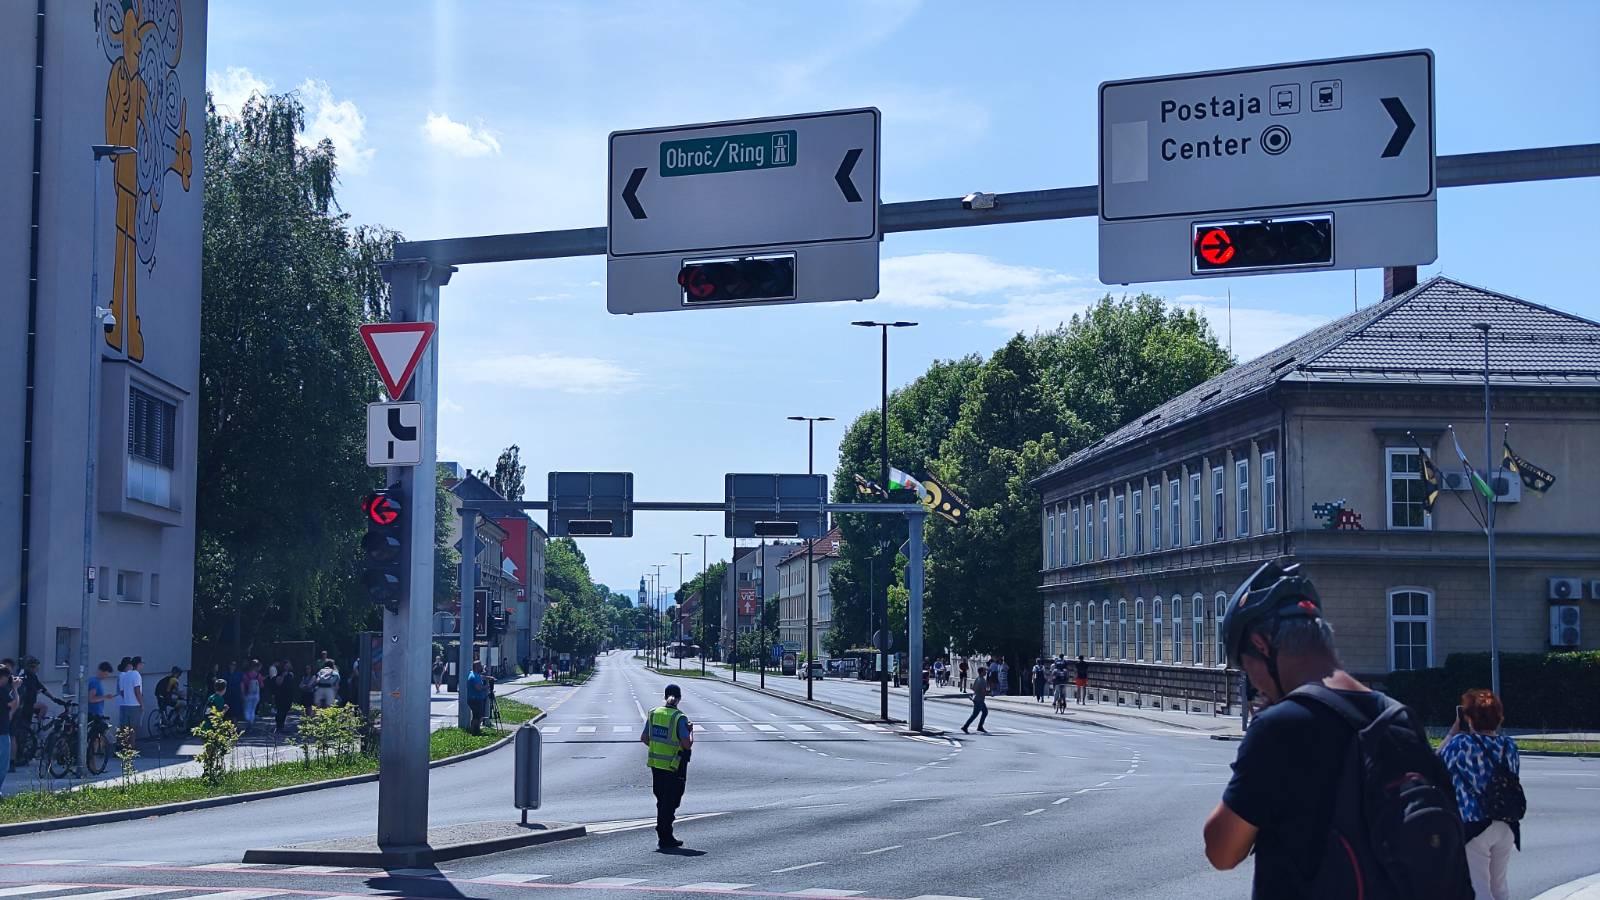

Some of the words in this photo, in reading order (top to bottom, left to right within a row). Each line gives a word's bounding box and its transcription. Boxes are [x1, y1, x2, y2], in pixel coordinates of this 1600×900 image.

[1161, 93, 1261, 123] Postaja
[666, 140, 765, 169] Obroč/Ring
[1161, 134, 1252, 162] Center
